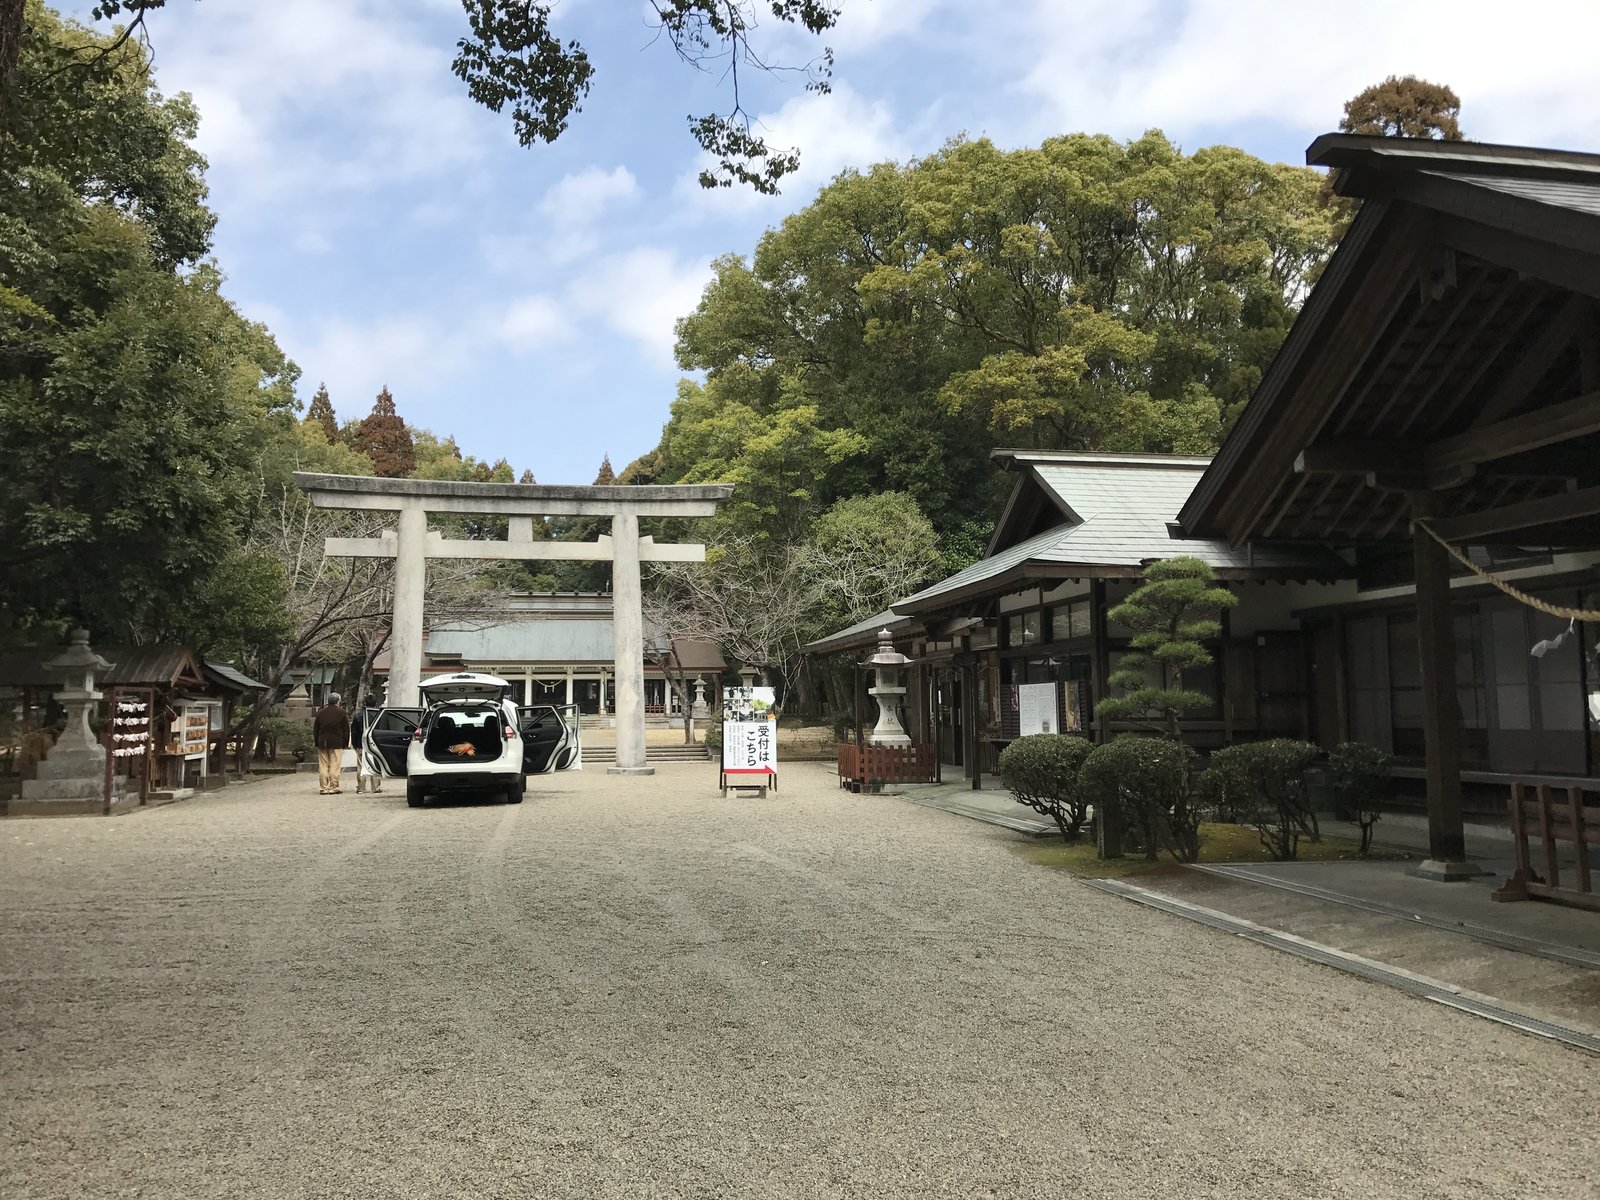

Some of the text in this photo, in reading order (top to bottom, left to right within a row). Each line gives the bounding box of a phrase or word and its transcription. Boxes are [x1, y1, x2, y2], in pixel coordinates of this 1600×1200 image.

[746, 731, 757, 767] こちら
[758, 725, 770, 762] 受付は
